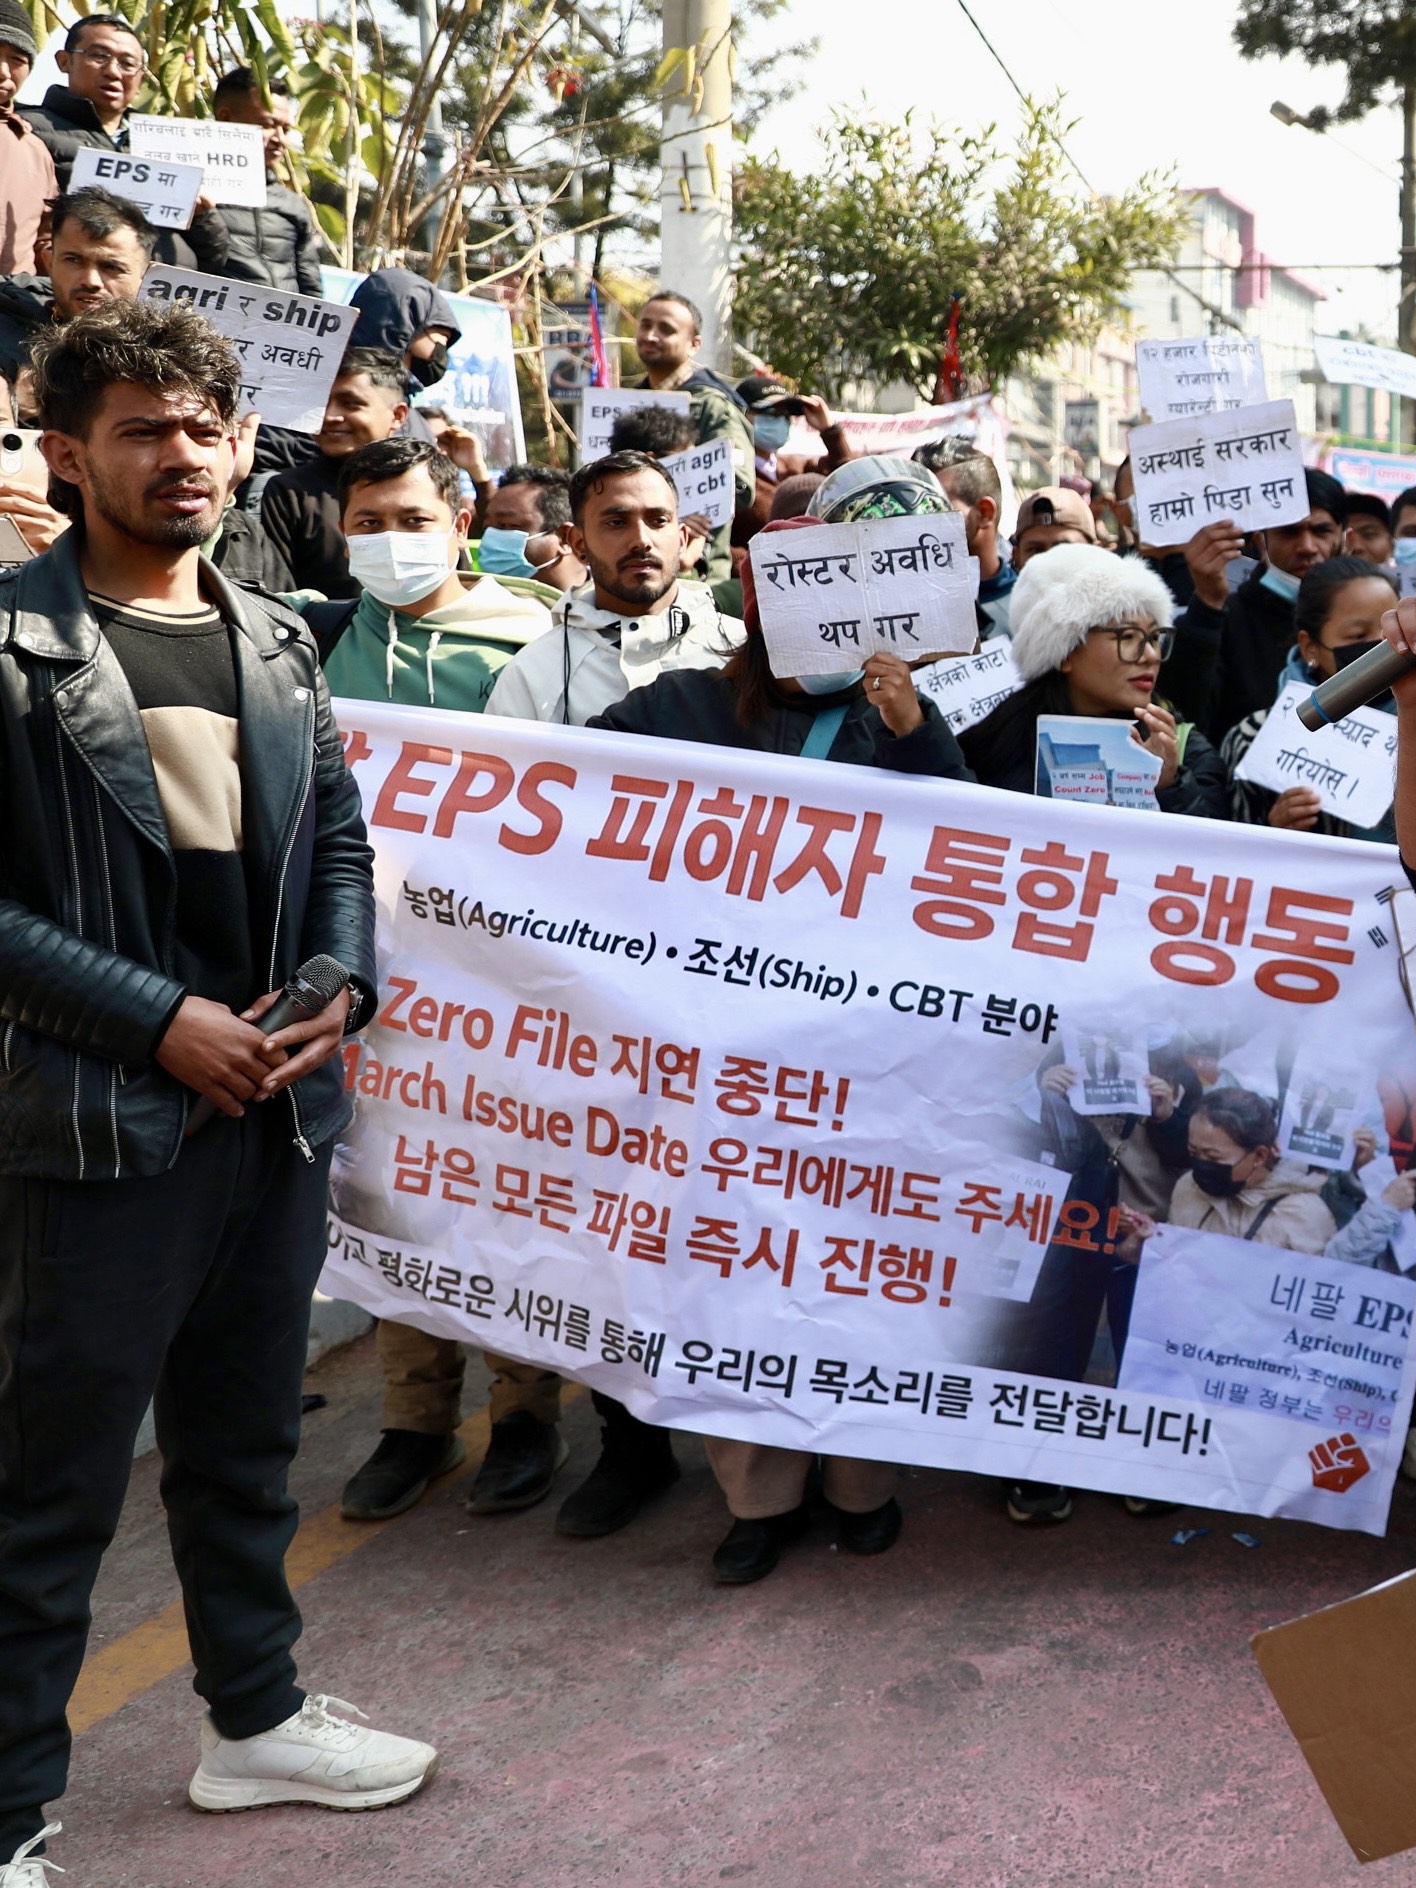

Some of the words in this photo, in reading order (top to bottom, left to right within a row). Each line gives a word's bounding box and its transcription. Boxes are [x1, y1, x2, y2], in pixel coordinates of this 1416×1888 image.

[95, 157, 150, 183] EPS
[157, 171, 178, 187] मा
[207, 152, 248, 167] HRD
[160, 204, 185, 222] गर
[239, 295, 256, 316] र
[263, 300, 341, 337] ship
[591, 405, 622, 419] EPS
[691, 442, 727, 470] agri
[1215, 427, 1293, 461] सरकार
[697, 472, 727, 495] cbt
[1149, 491, 1195, 527] हाम्रो
[1261, 477, 1295, 508] सुन
[761, 552, 857, 591] रोस्टर
[871, 532, 954, 576] अवधि
[818, 618, 861, 648] थप
[873, 611, 920, 642] गर
[1054, 785, 1082, 793] Count
[1085, 785, 1106, 793] Zero
[370, 741, 577, 855] EPS
[585, 774, 886, 919] 피해자
[910, 825, 1119, 963] 통합
[1148, 865, 1355, 1004] 행동
[889, 980, 973, 1023] CBT
[981, 993, 1059, 1044] 분야
[379, 976, 494, 1050] Zero
[505, 1004, 598, 1078] File
[610, 1034, 701, 1104] 지연
[714, 1055, 849, 1132] 중단!
[463, 1074, 574, 1148] Issue
[586, 1106, 689, 1178] Date
[700, 1137, 941, 1222] 우리에게도
[954, 1181, 1121, 1255] 주세요!
[393, 1135, 481, 1206] 남은
[492, 1163, 577, 1233] 모든
[586, 1188, 672, 1265] 파일
[685, 1215, 800, 1288] 즉시
[819, 1235, 958, 1308] 진행!
[376, 1249, 497, 1320] 평화로운
[504, 1289, 591, 1353] 시위를
[600, 1318, 667, 1378] 통해
[674, 1339, 797, 1398] 우리의
[809, 1357, 974, 1420] 목소리를
[989, 1382, 1212, 1457] 전달합니다!
[1283, 1327, 1403, 1369] Agriculture
